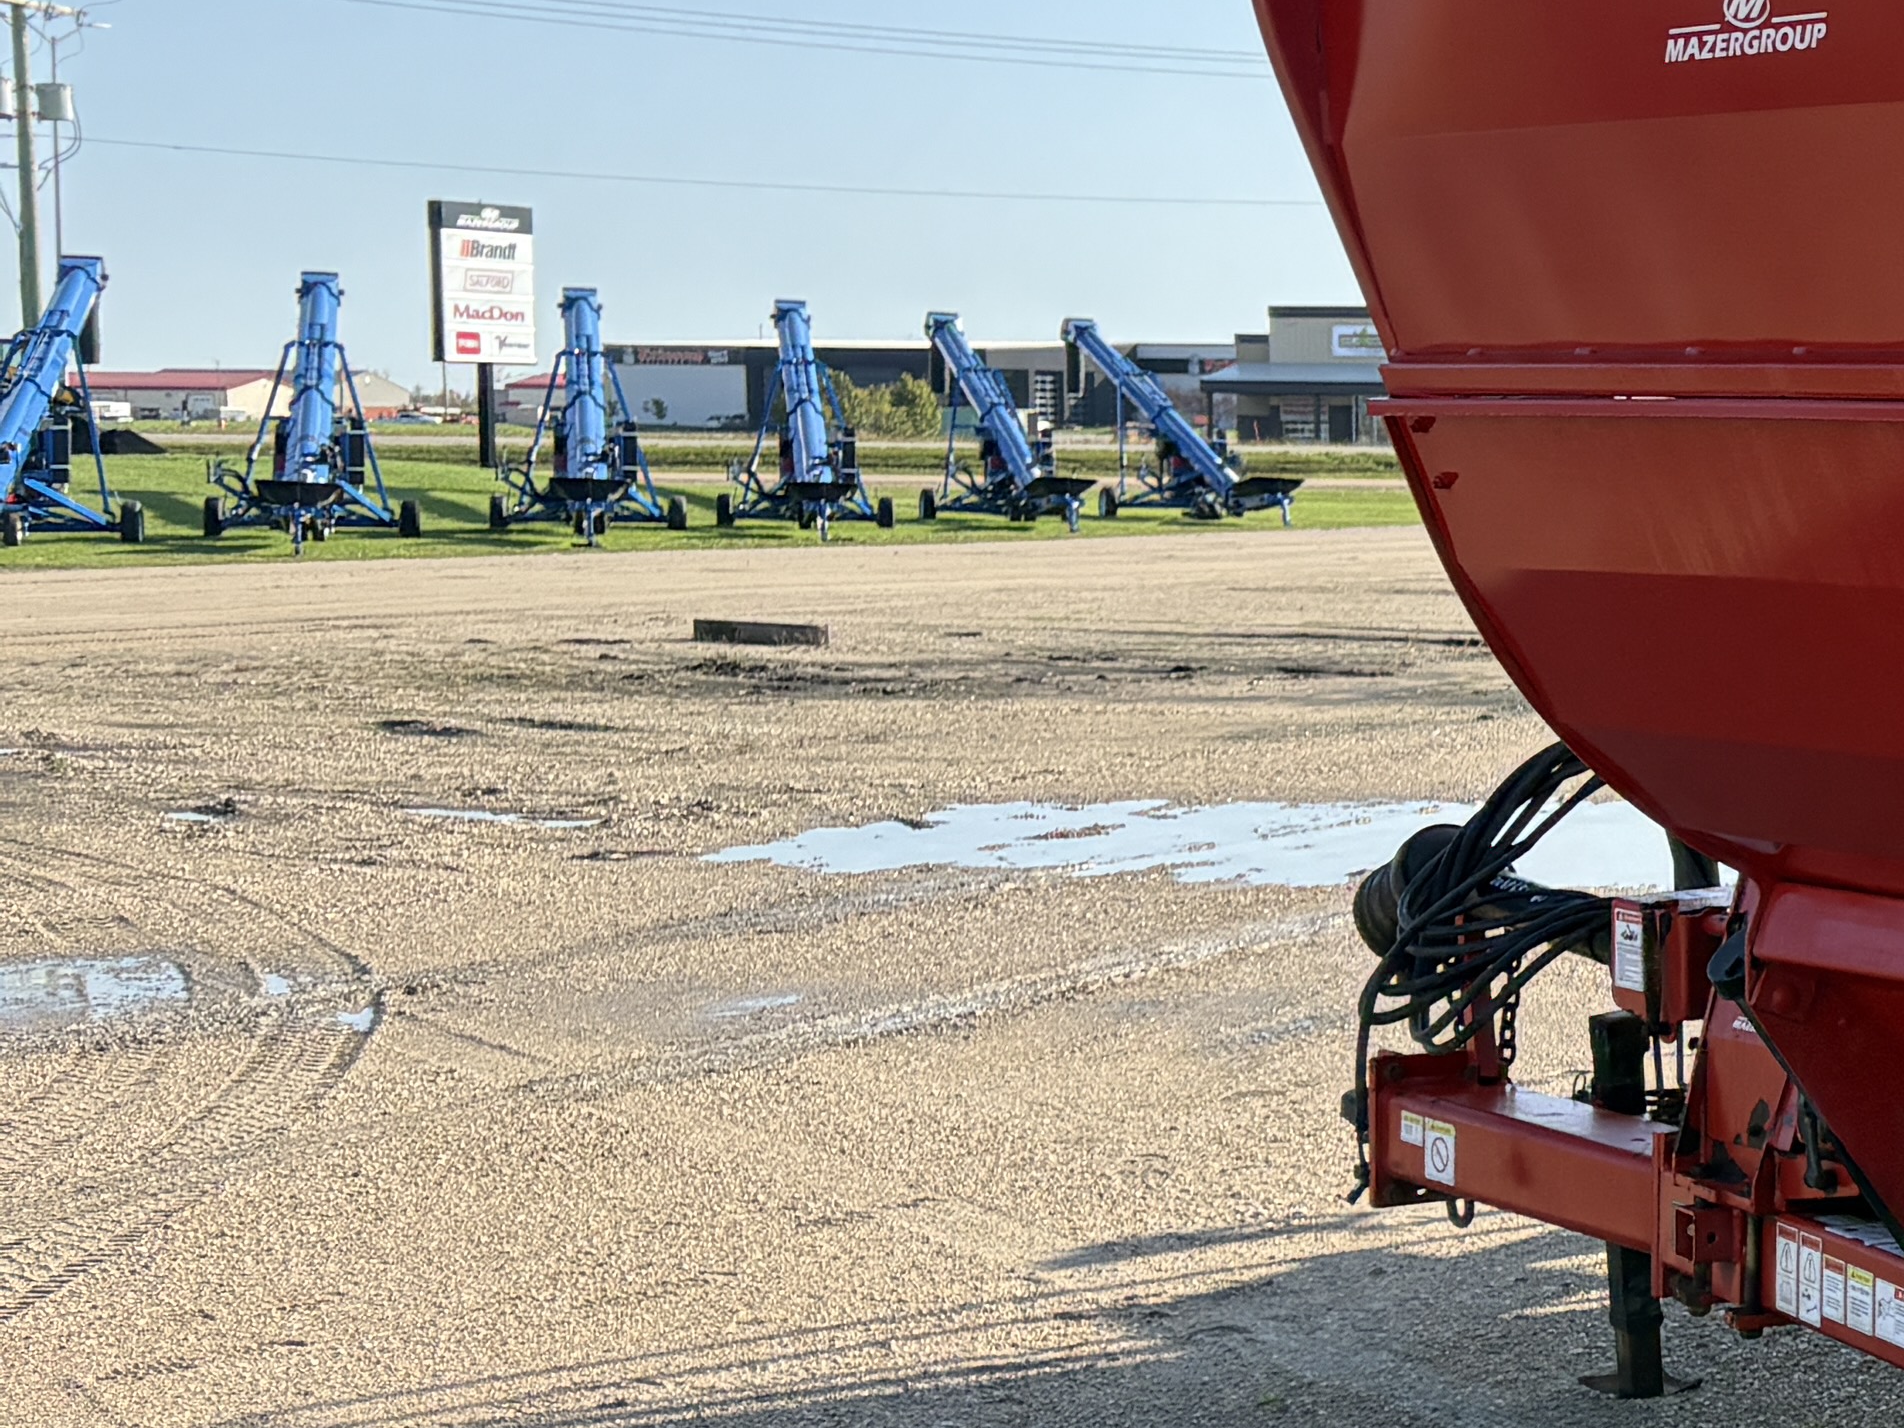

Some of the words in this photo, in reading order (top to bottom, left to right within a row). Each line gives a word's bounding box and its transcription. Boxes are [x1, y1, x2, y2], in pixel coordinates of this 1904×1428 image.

[1664, 22, 1828, 64] MAZERGROUP
[470, 239, 517, 261] Brandt
[453, 303, 525, 323] MacDon
